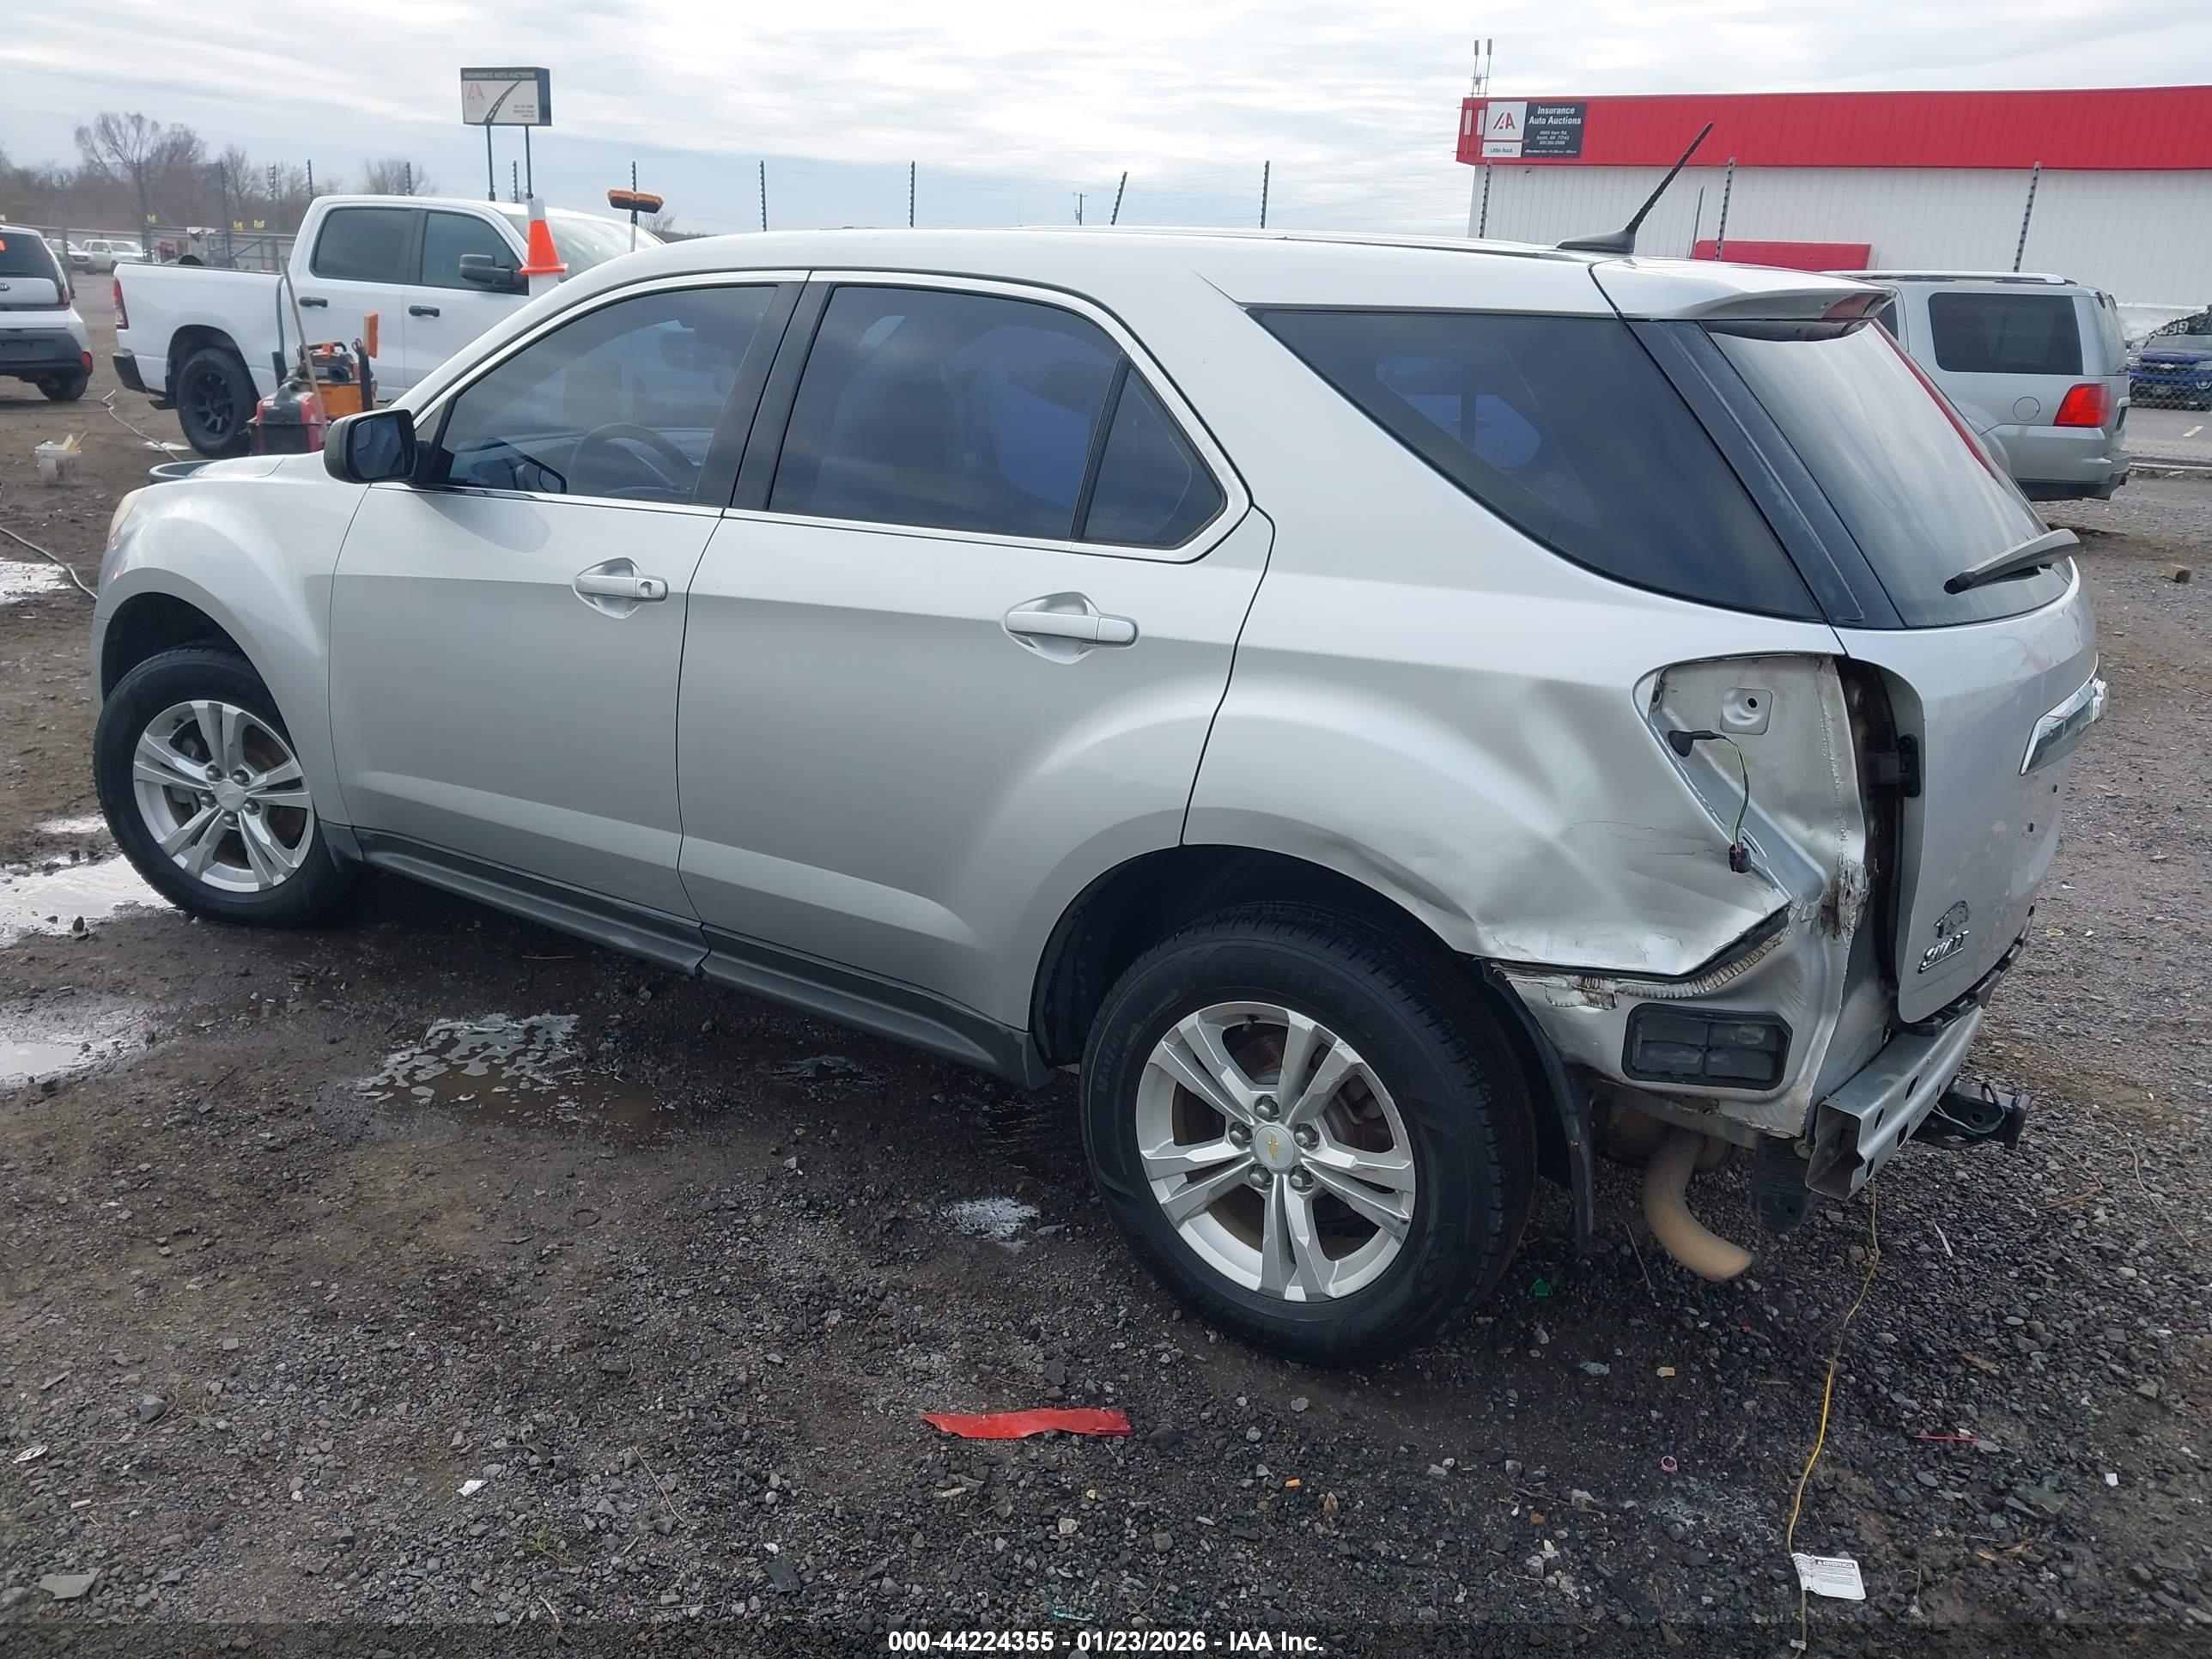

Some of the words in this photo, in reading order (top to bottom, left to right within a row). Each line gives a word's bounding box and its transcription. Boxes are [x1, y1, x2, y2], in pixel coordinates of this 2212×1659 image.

[1537, 106, 1575, 114] Insurance
[1528, 115, 1547, 125] Auto
[1547, 115, 1582, 125] Auctions
